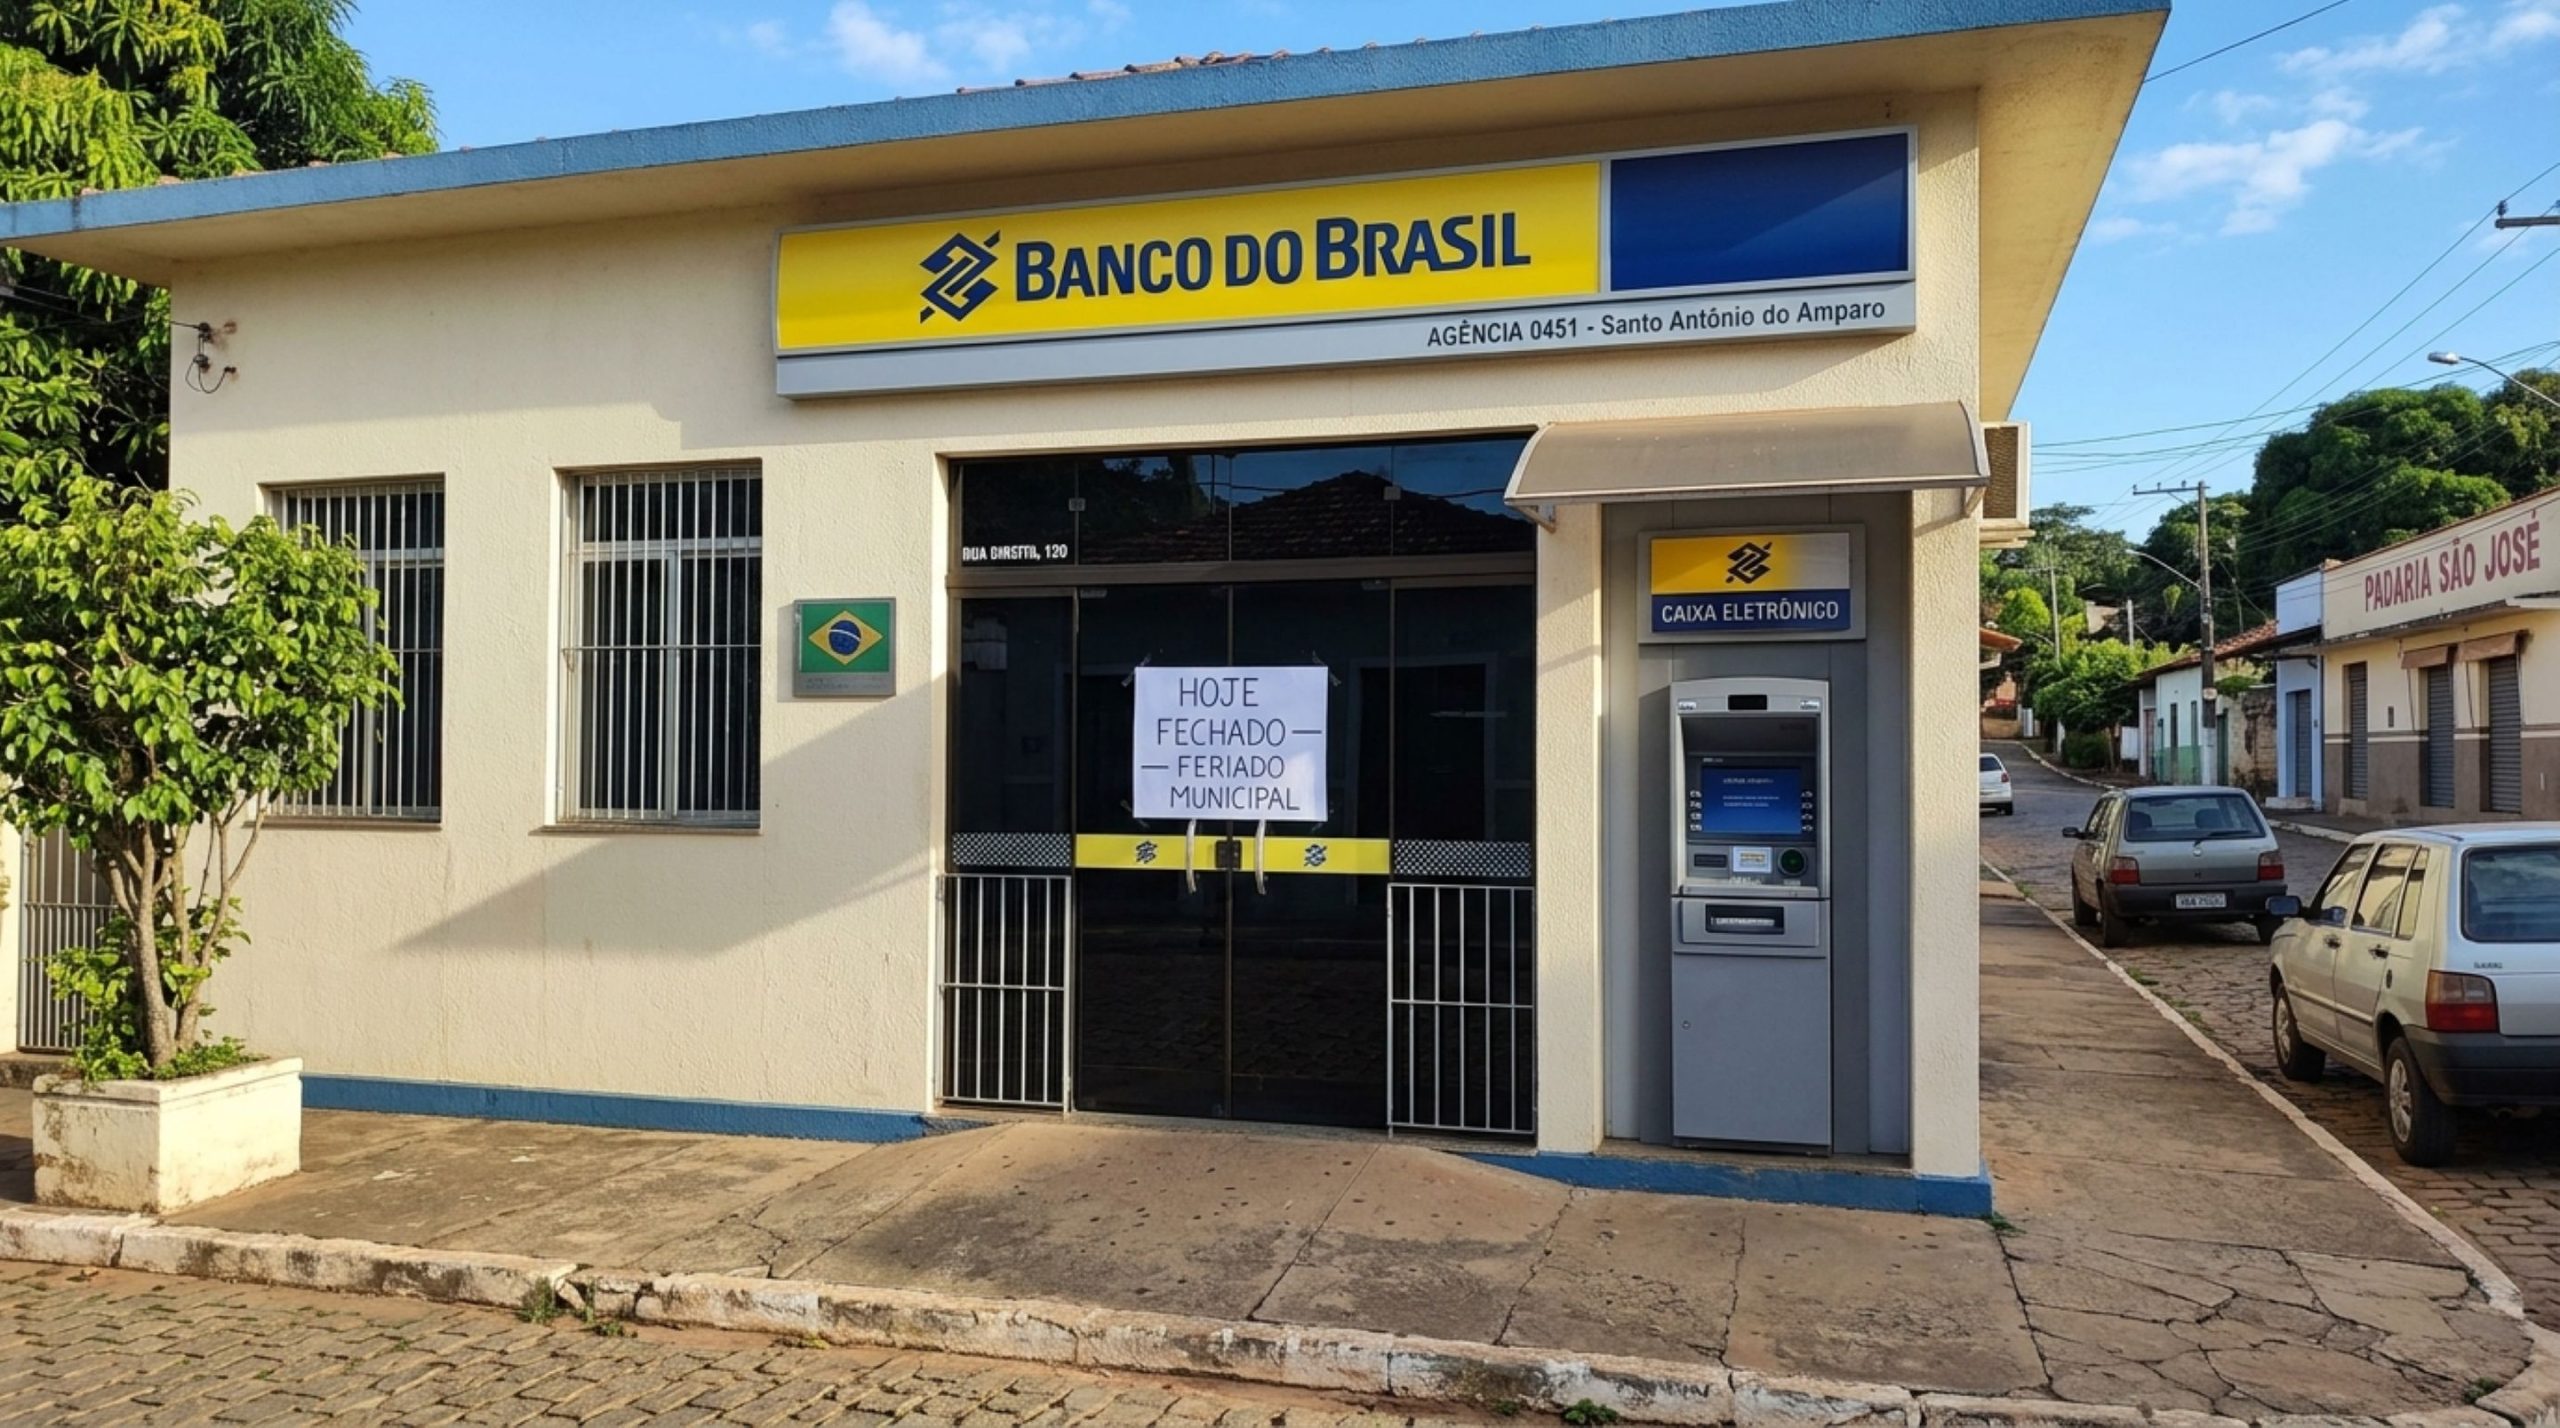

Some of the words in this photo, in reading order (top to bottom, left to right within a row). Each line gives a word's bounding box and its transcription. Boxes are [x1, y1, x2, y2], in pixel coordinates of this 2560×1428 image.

[1015, 237, 1213, 302] BANCO
[1224, 230, 1303, 287] DO
[1315, 211, 1531, 281] BRASIL
[1427, 319, 1524, 347] AGÊNCIA
[1530, 316, 1577, 340] 0451
[1601, 313, 1664, 335] Santo
[1669, 306, 1755, 331] António
[1762, 304, 1790, 325] do
[1796, 301, 1886, 325] Amparo
[1045, 543, 1068, 559] 120
[2365, 556, 2432, 613] PADARIA
[2439, 537, 2476, 593] SÃO
[2485, 508, 2540, 582] JOSÉ
[1662, 604, 1717, 623] CAIXA
[1723, 598, 1839, 621] ELETRÔNICO
[1179, 677, 1259, 707] HOJE
[1157, 718, 1286, 747] FECHADO
[1178, 755, 1285, 779] FERIADO
[1170, 785, 1300, 811] MUNICIPAL
